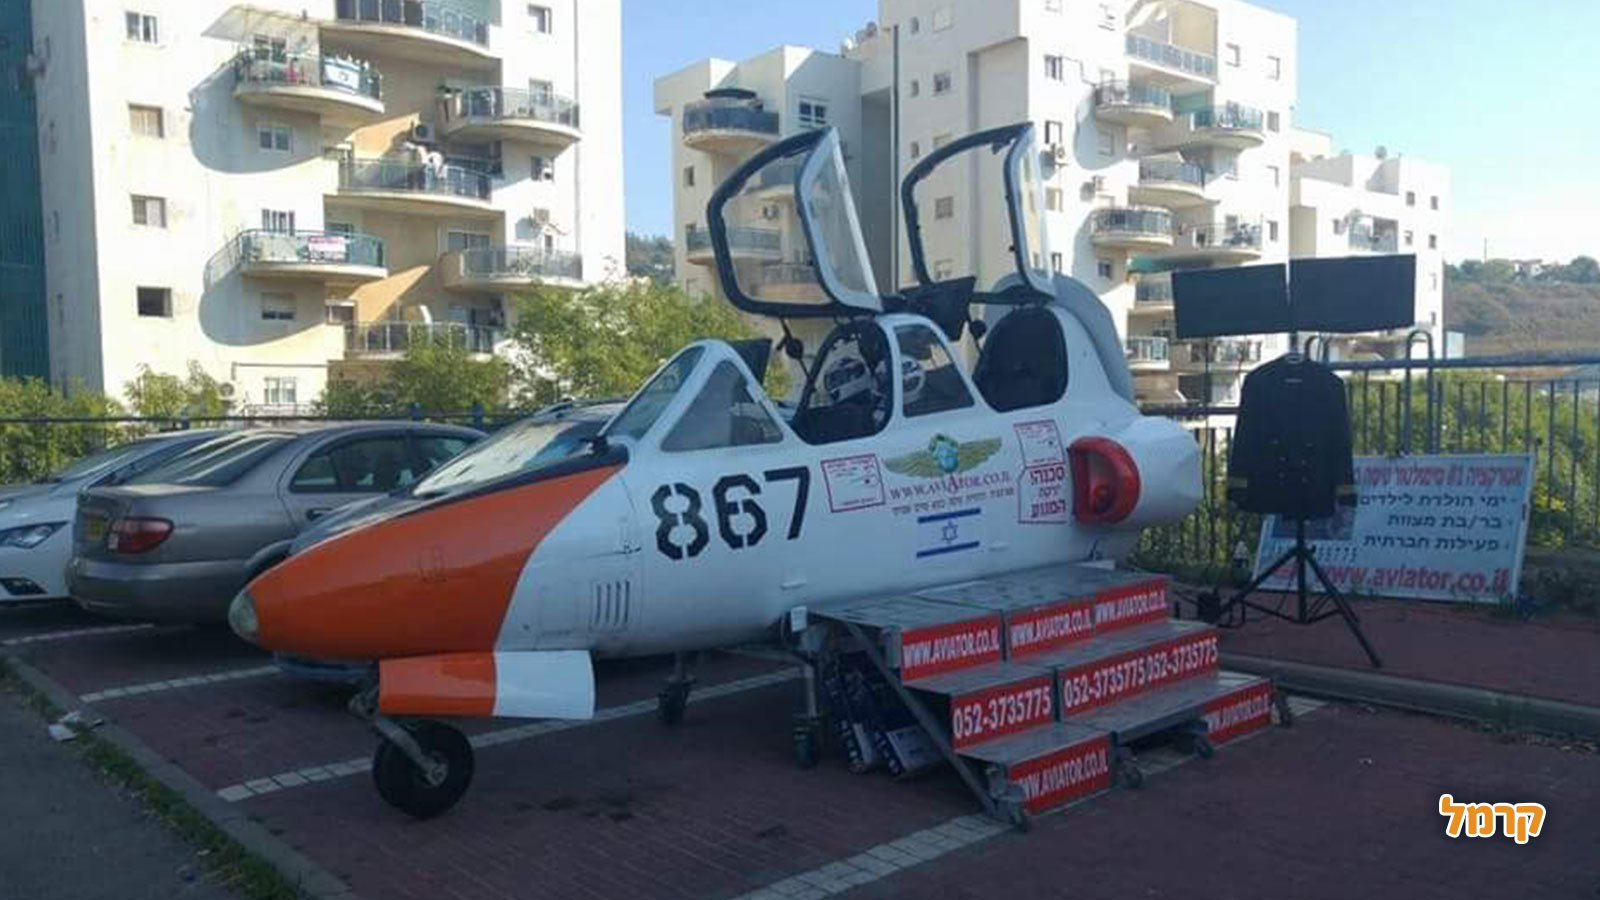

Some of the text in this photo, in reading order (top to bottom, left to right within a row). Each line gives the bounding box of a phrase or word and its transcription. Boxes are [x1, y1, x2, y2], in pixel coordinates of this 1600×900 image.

[651, 465, 810, 560] 867
[1360, 492, 1507, 508] ימי הולדת לילדים
[1388, 513, 1503, 529] בר/בת מצוות
[1363, 533, 1500, 551] פעילות חברתית
[902, 626, 1000, 669] WWW.AVIATOR.CO.IL
[1011, 608, 1092, 648] WWW.AVIATOR.CO.IL
[1063, 636, 1219, 708] 052-3735775 052-3735775
[952, 685, 1051, 739] 052-3735775
